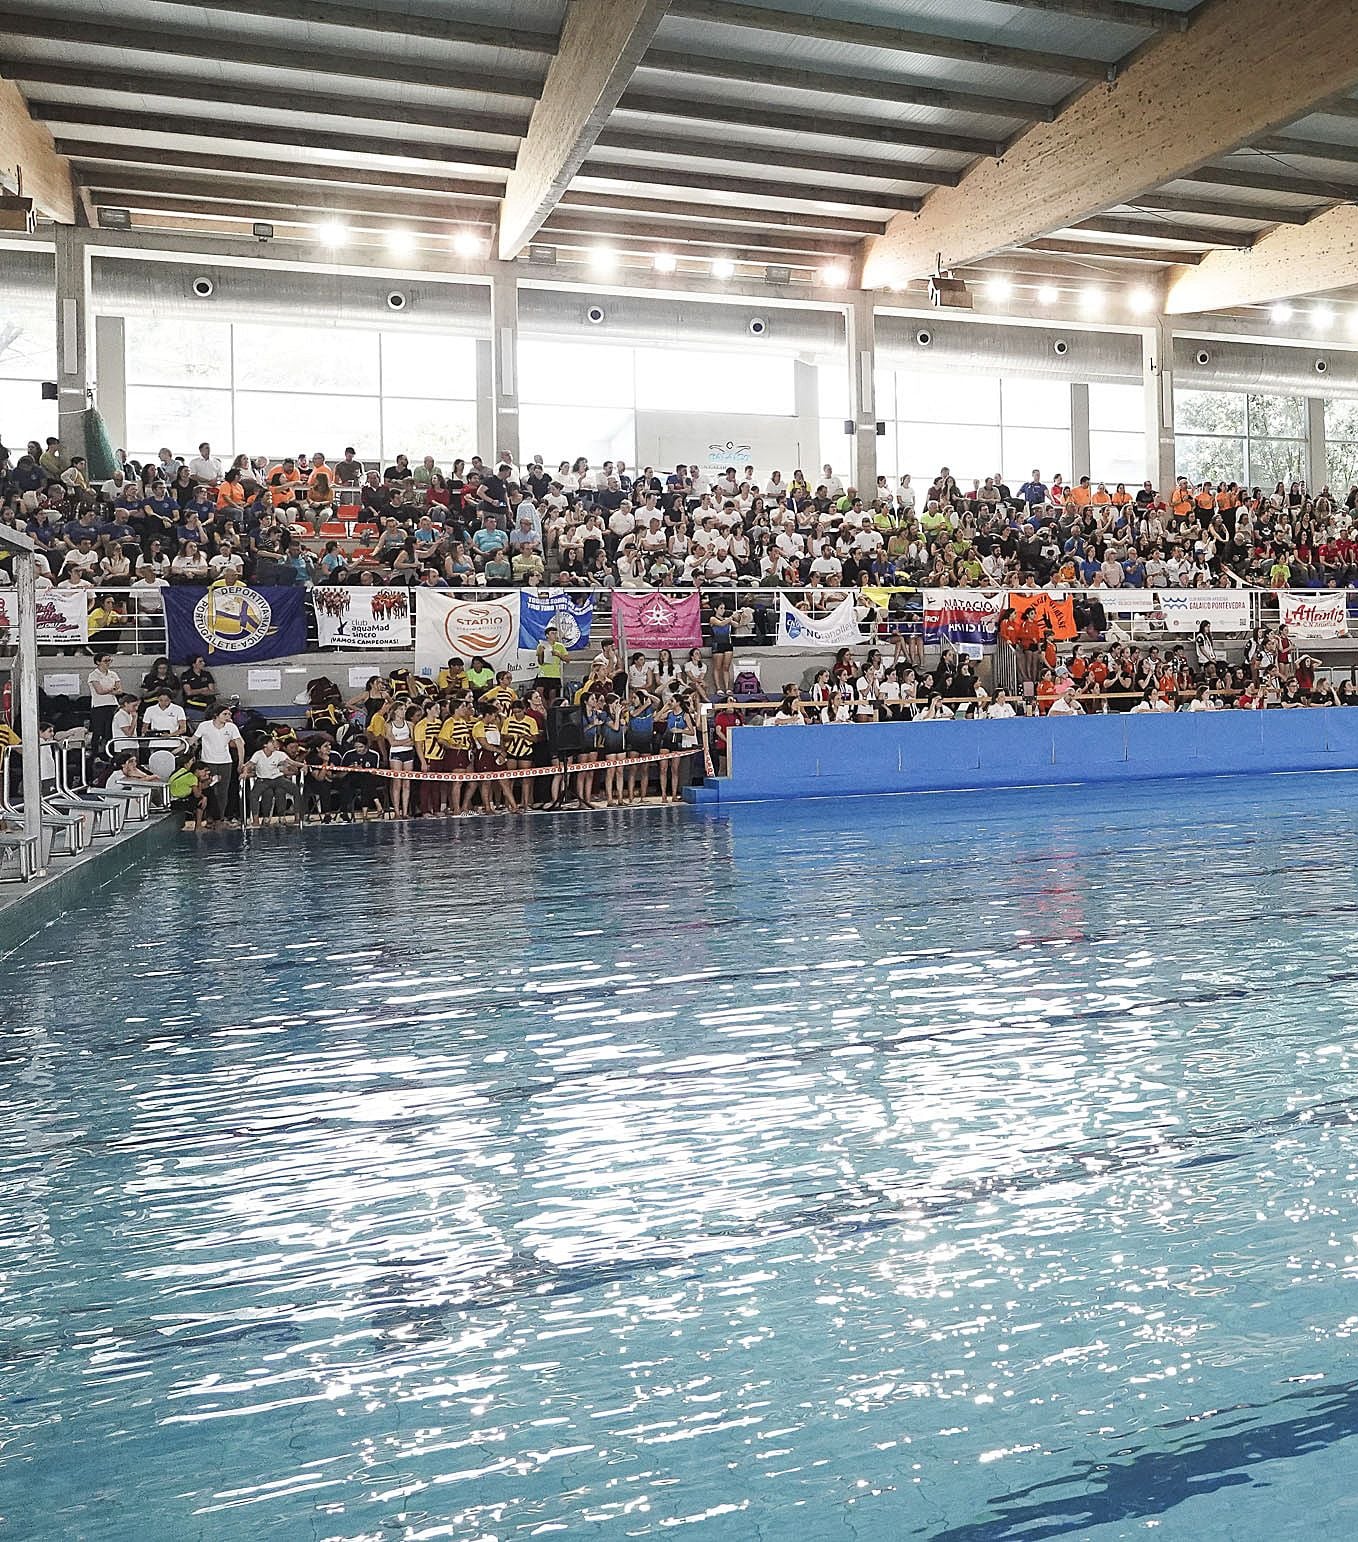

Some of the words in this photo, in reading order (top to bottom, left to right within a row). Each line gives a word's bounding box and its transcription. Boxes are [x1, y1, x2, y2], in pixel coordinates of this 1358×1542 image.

[221, 586, 270, 617] DEPORTIVA
[1211, 601, 1246, 609] PONTEVEDRA
[1292, 604, 1345, 623] Atlantis
[456, 616, 503, 625] STADIO
[351, 624, 390, 633] aquaMad
[948, 621, 998, 634] ARTISTIC
